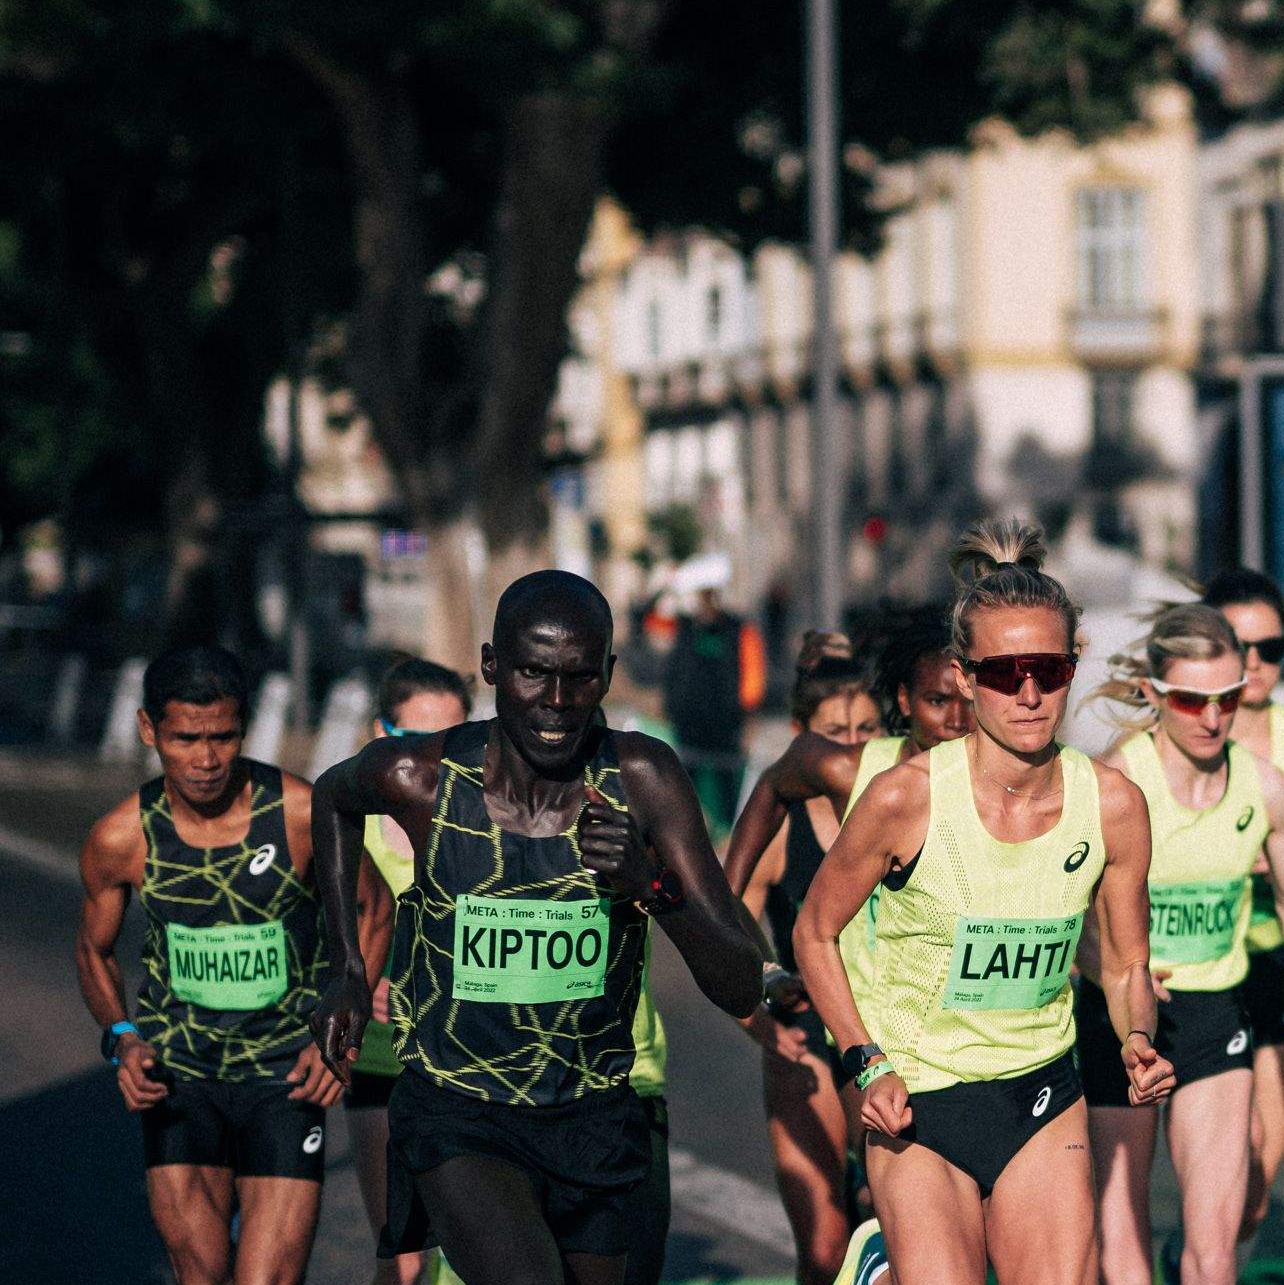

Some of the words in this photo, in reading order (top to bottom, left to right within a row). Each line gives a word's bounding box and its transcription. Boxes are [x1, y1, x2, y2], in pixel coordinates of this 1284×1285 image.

[466, 905, 499, 918] META
[508, 908, 535, 919] Time
[545, 909, 574, 921] Trials
[581, 905, 600, 919] 57
[966, 924, 995, 934] META
[1003, 924, 1026, 934] Time
[1034, 925, 1058, 934] Trials
[1063, 918, 1077, 932] 78
[174, 946, 280, 983] MUHAIZAR
[461, 925, 602, 971] KIPTOO
[960, 939, 1072, 980] LAHTI
